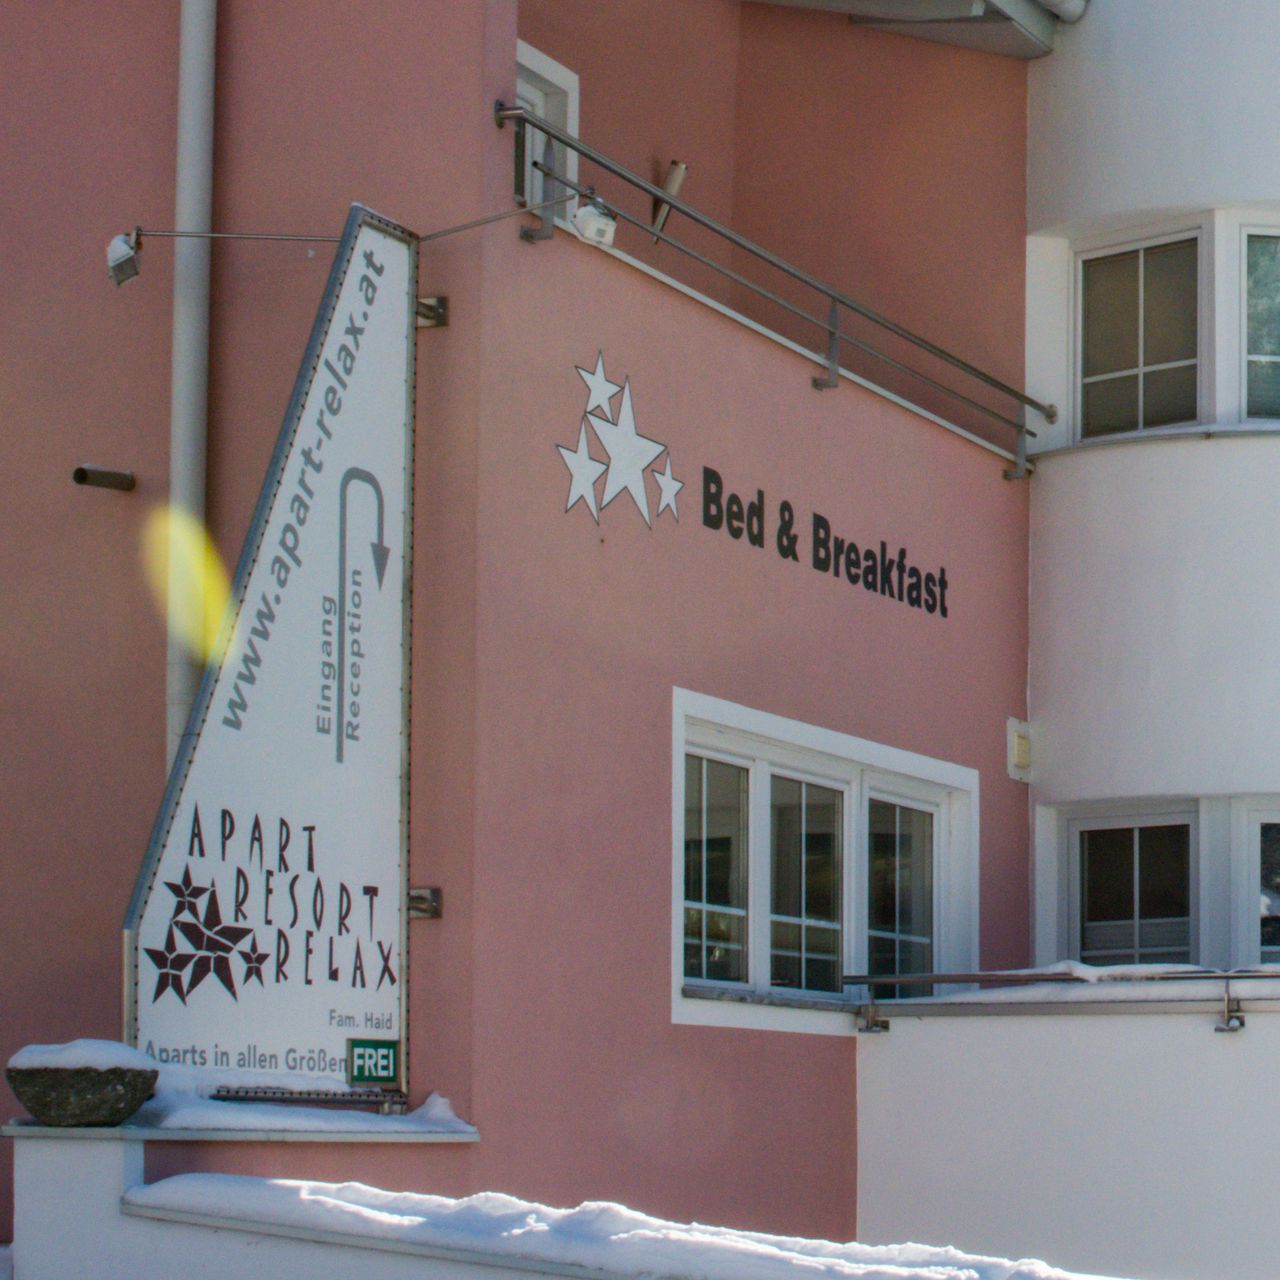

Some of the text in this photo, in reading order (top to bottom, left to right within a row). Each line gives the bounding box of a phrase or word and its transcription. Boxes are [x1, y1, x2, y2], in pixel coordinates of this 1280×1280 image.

[222, 249, 385, 731] www.apart-relax.at
[702, 466, 948, 618] Bed & Breakfast
[316, 595, 337, 735] Eingang
[345, 568, 365, 742] Reception
[188, 801, 316, 873] APART
[234, 866, 379, 942] RESORT
[275, 927, 397, 992] RELAX
[145, 1039, 347, 1073] Aparts in allen Größen
[328, 1008, 393, 1030] Fam. Haid
[352, 1046, 395, 1078] FREI
